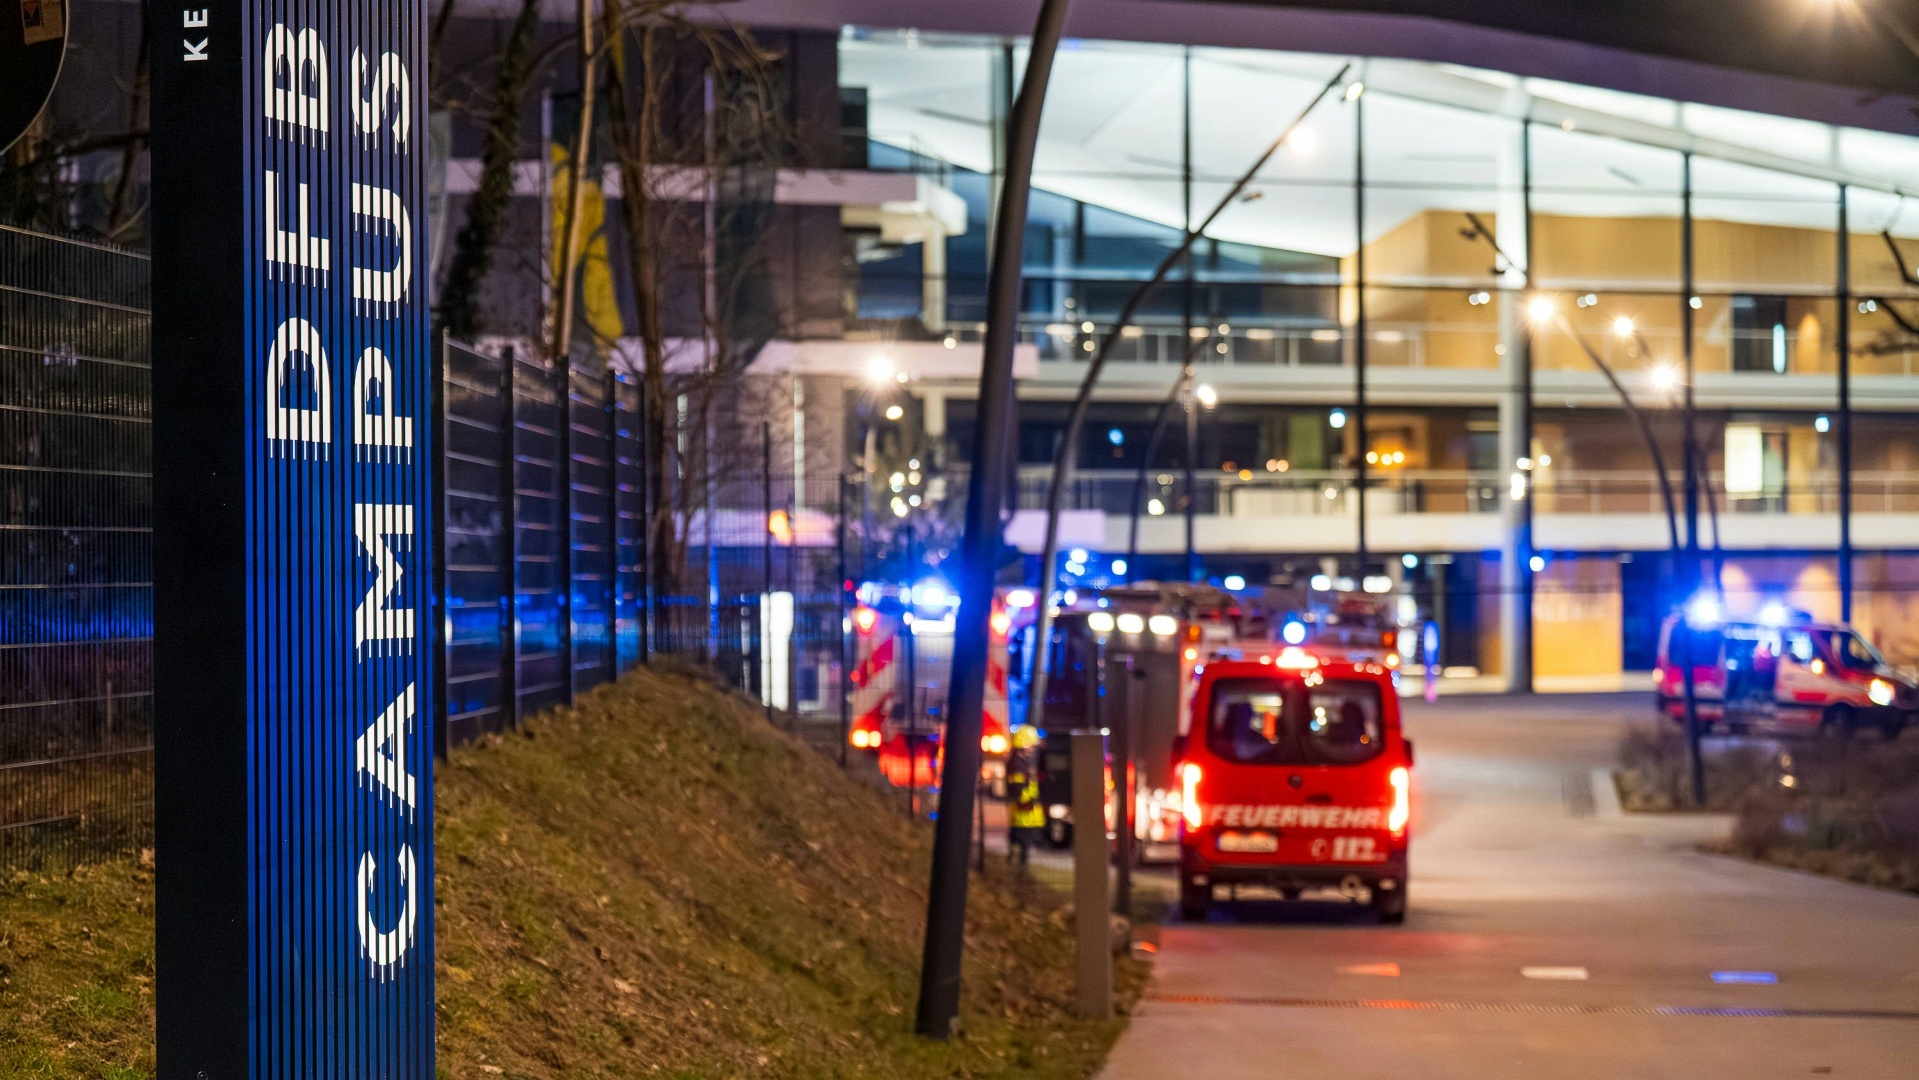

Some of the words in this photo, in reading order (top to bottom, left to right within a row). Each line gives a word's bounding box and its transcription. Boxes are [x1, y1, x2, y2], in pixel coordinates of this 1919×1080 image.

[265, 23, 331, 462] DFB
[352, 45, 417, 984] CAMPUS
[1209, 804, 1381, 828] FEUERWEHR
